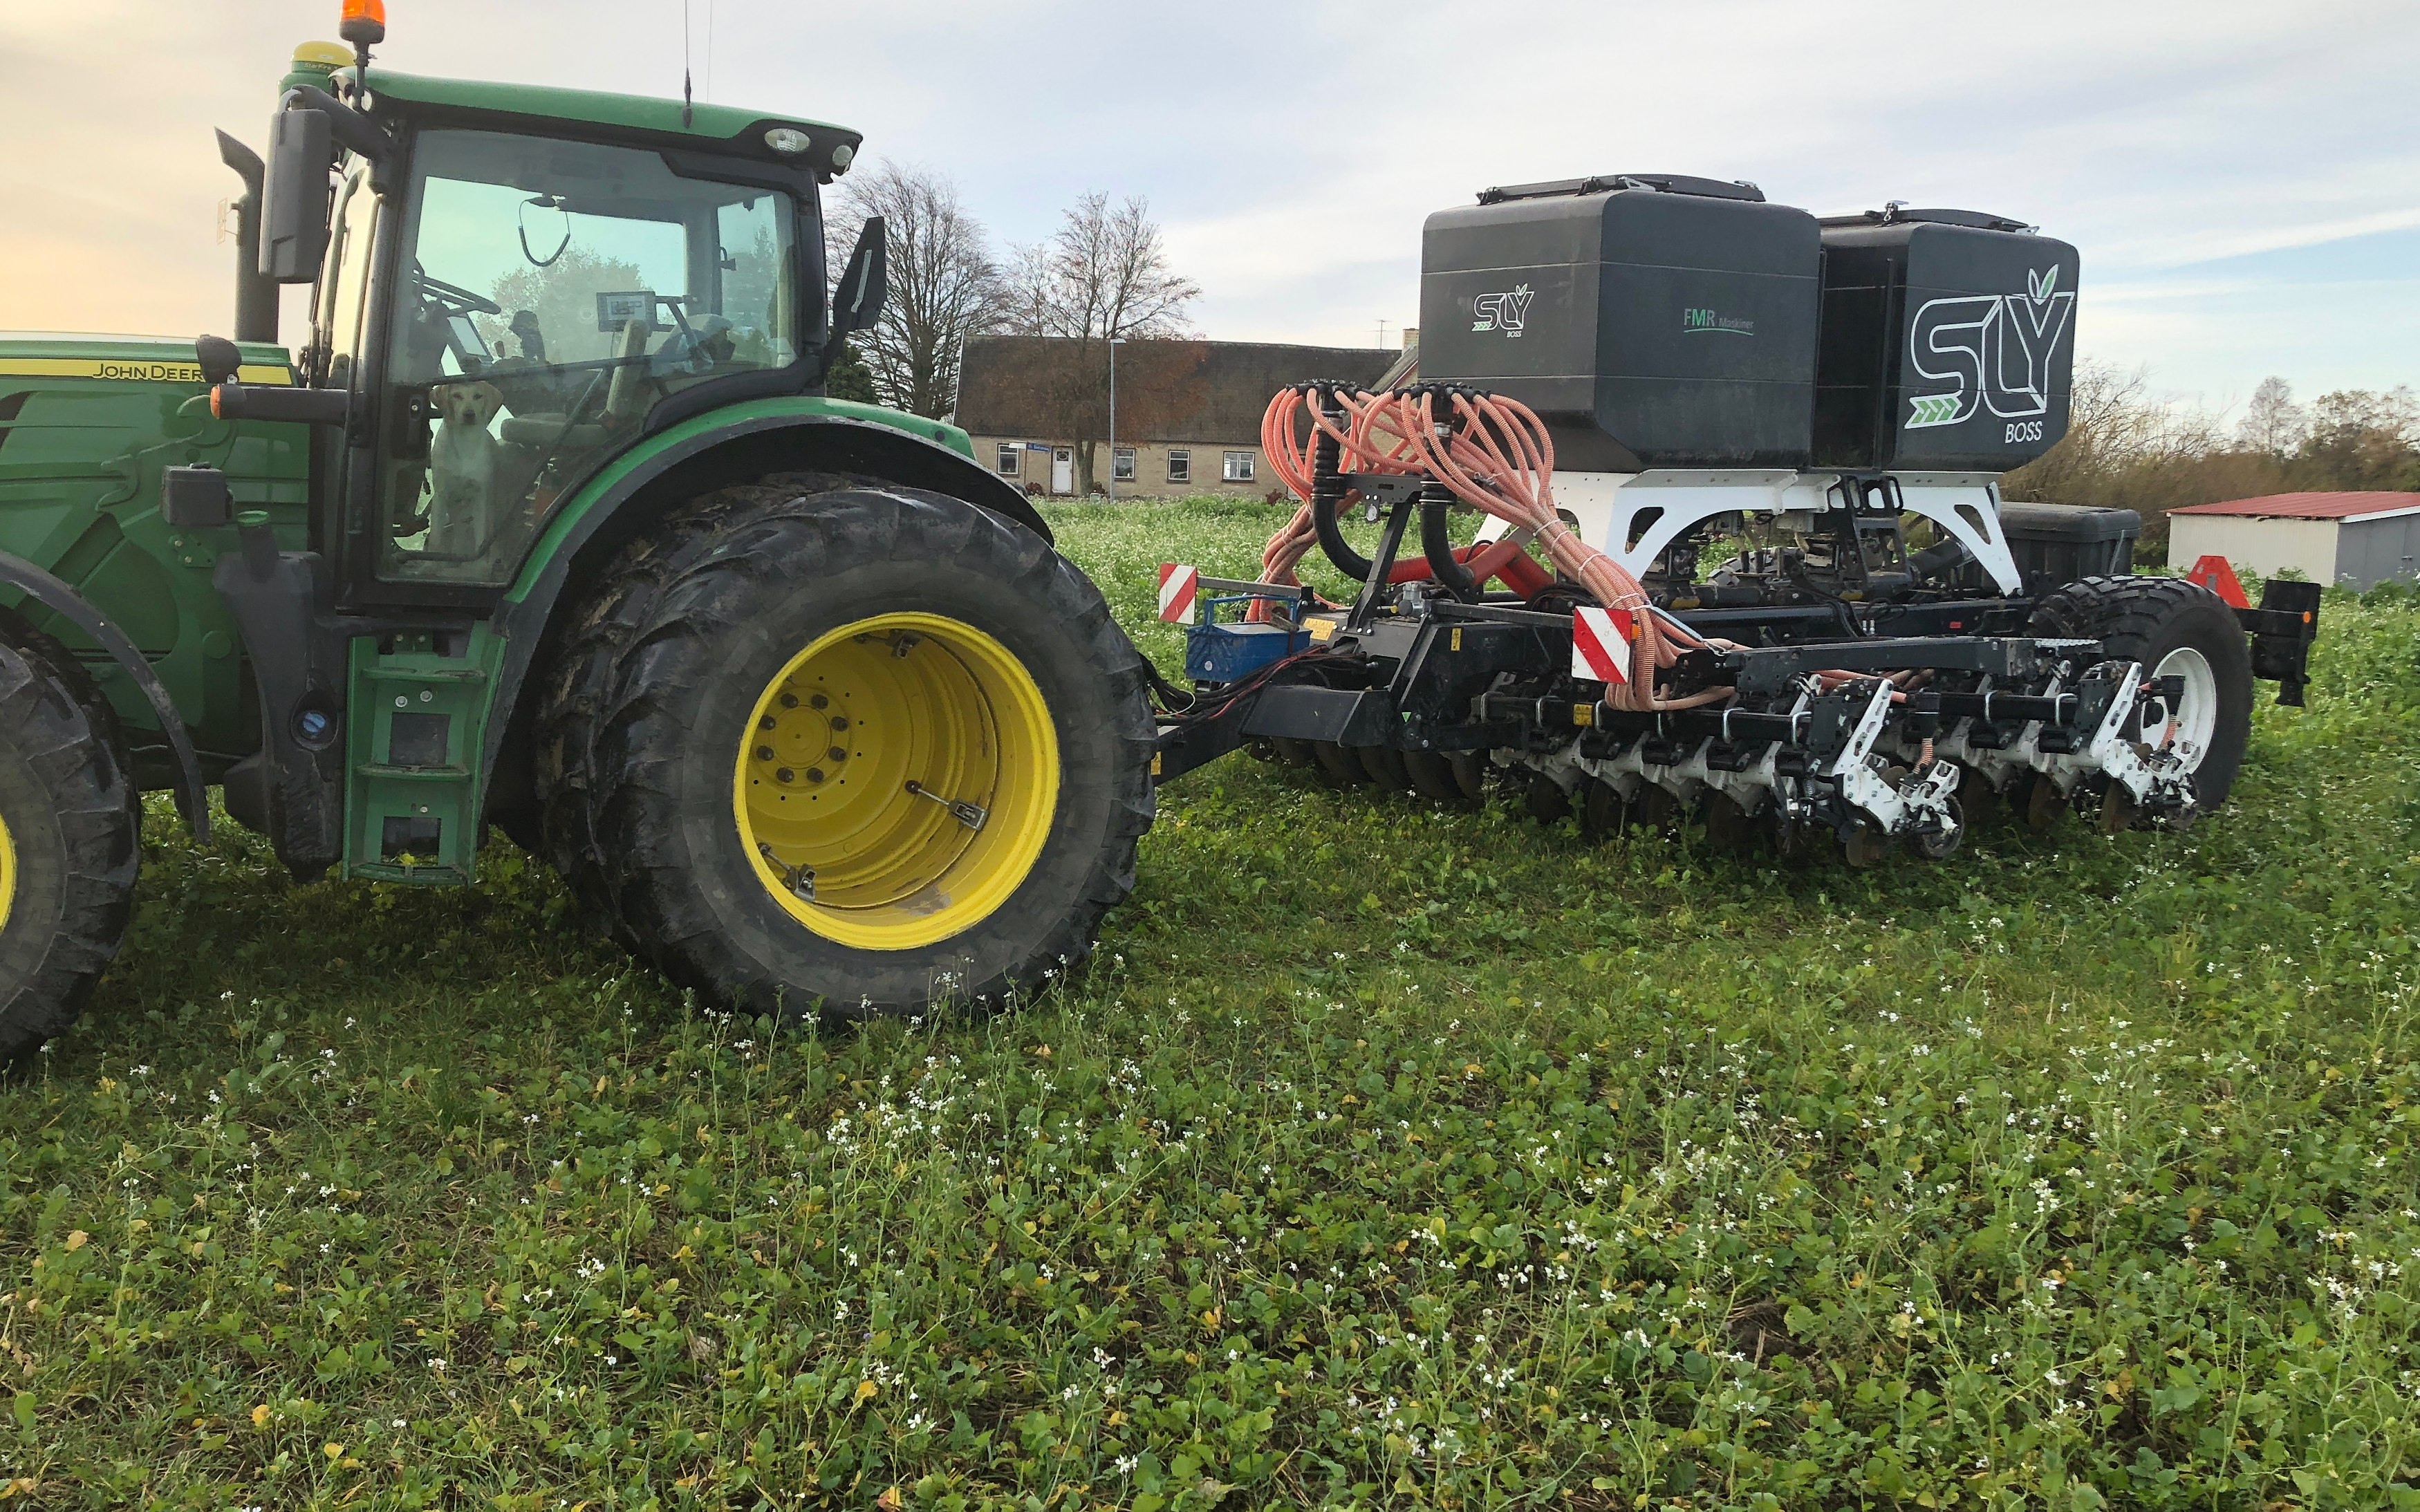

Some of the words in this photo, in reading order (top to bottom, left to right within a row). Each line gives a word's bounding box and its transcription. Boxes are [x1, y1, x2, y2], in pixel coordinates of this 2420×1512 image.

[1471, 290, 1534, 331] SLY
[1684, 308, 1715, 326] FMR
[1719, 318, 1754, 328] Maskiner
[1904, 291, 2075, 429] SLY
[93, 363, 147, 378] JOHN
[151, 365, 205, 381] DEER
[2005, 421, 2043, 443] BOSS
